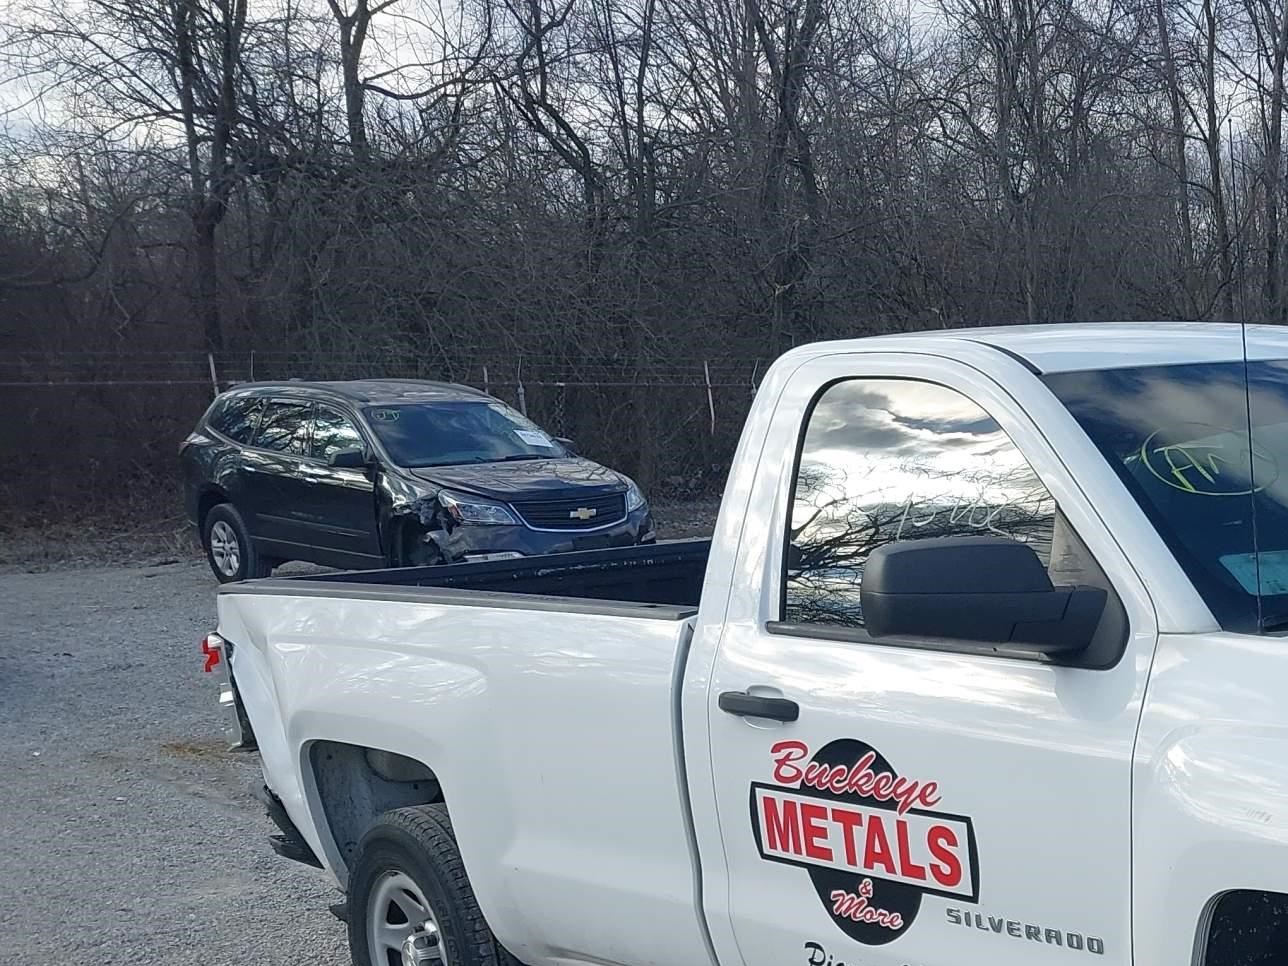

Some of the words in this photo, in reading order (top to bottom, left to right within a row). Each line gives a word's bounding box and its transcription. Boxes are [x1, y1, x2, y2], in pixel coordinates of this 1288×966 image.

[770, 740, 942, 815] Buckeye
[762, 796, 962, 888] METALS
[830, 889, 904, 930] More
[857, 878, 874, 898] &
[945, 907, 1105, 956] SILVERADO
